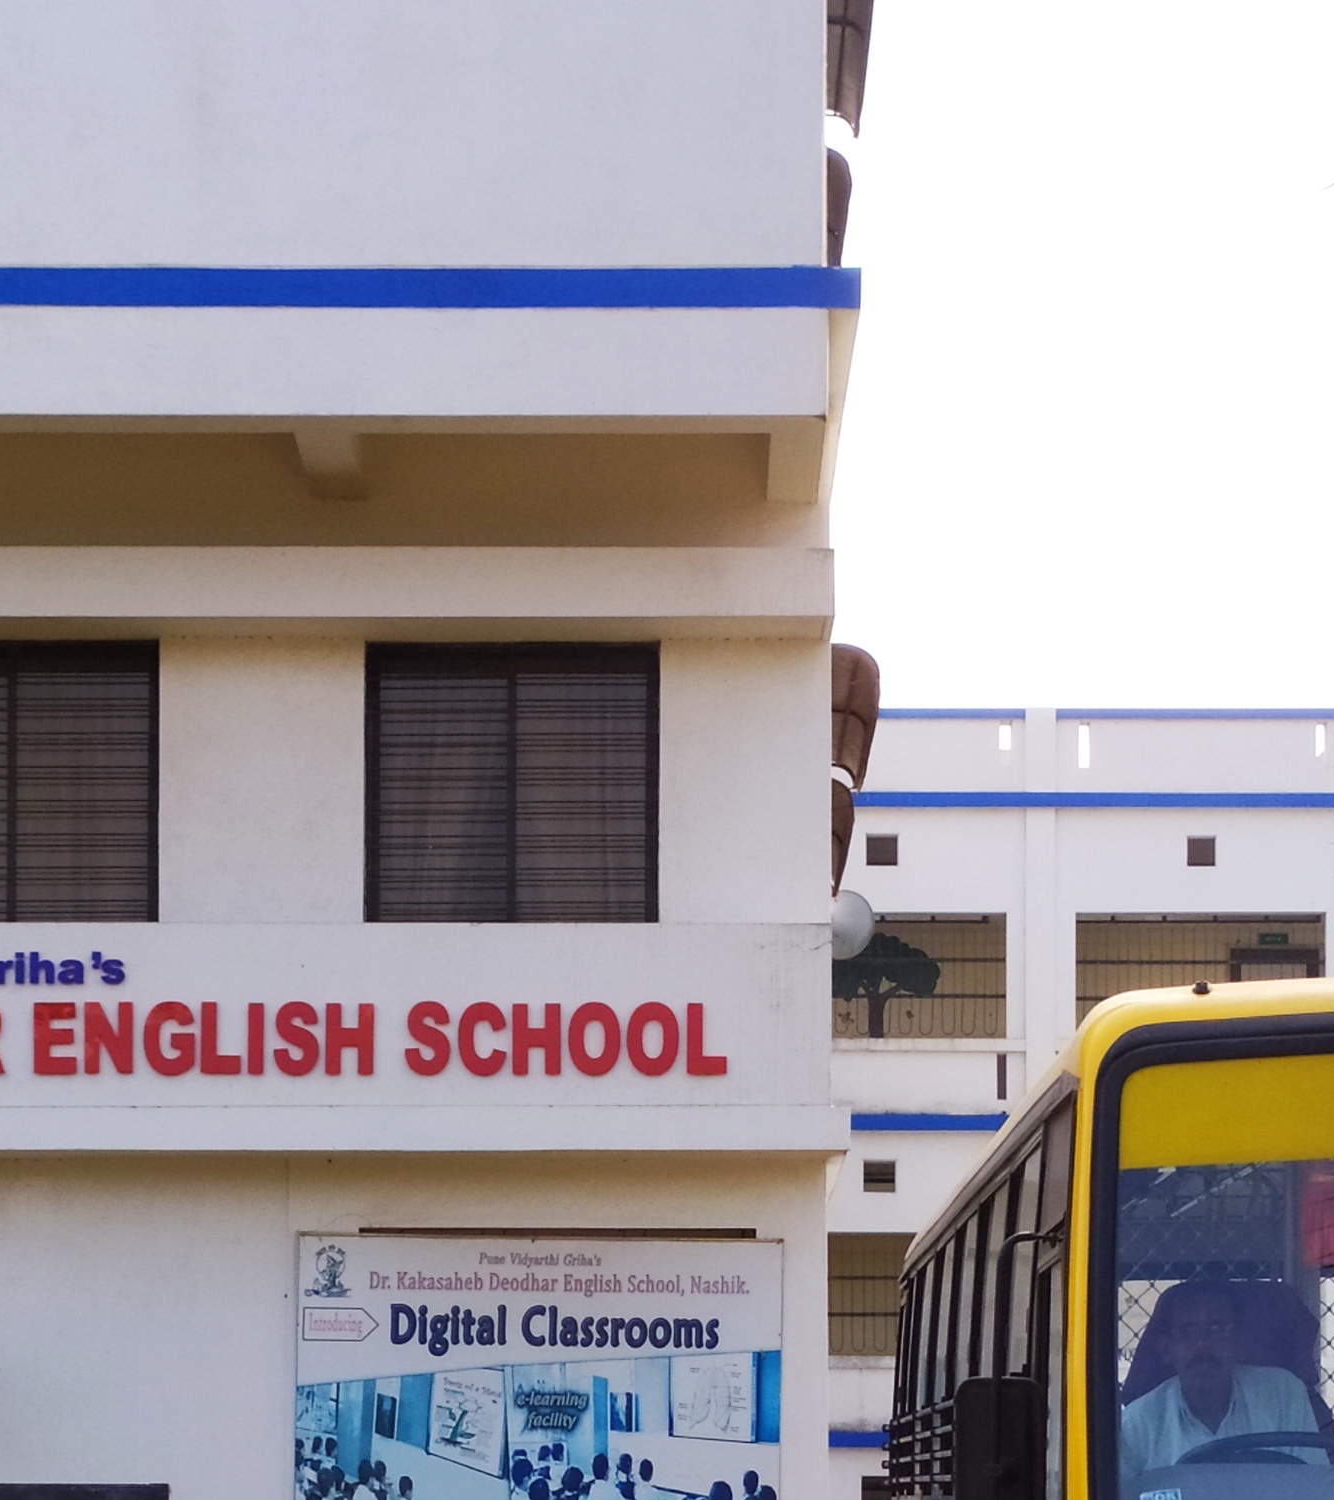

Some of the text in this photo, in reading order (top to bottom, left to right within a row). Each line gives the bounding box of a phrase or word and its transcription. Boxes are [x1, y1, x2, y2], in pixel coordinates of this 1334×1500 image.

[32, 1001, 375, 1077] ENGLISH
[404, 1001, 728, 1077] SCHOOL
[478, 1252, 602, 1268] Pune Vidyarthi Griha's
[369, 1271, 750, 1297] Dr. Kakasaheb Deodhar English School, Nashik.
[309, 1312, 363, 1338] Introducing
[390, 1303, 720, 1356] Digital Classrooms
[528, 1411, 577, 1429] facility
